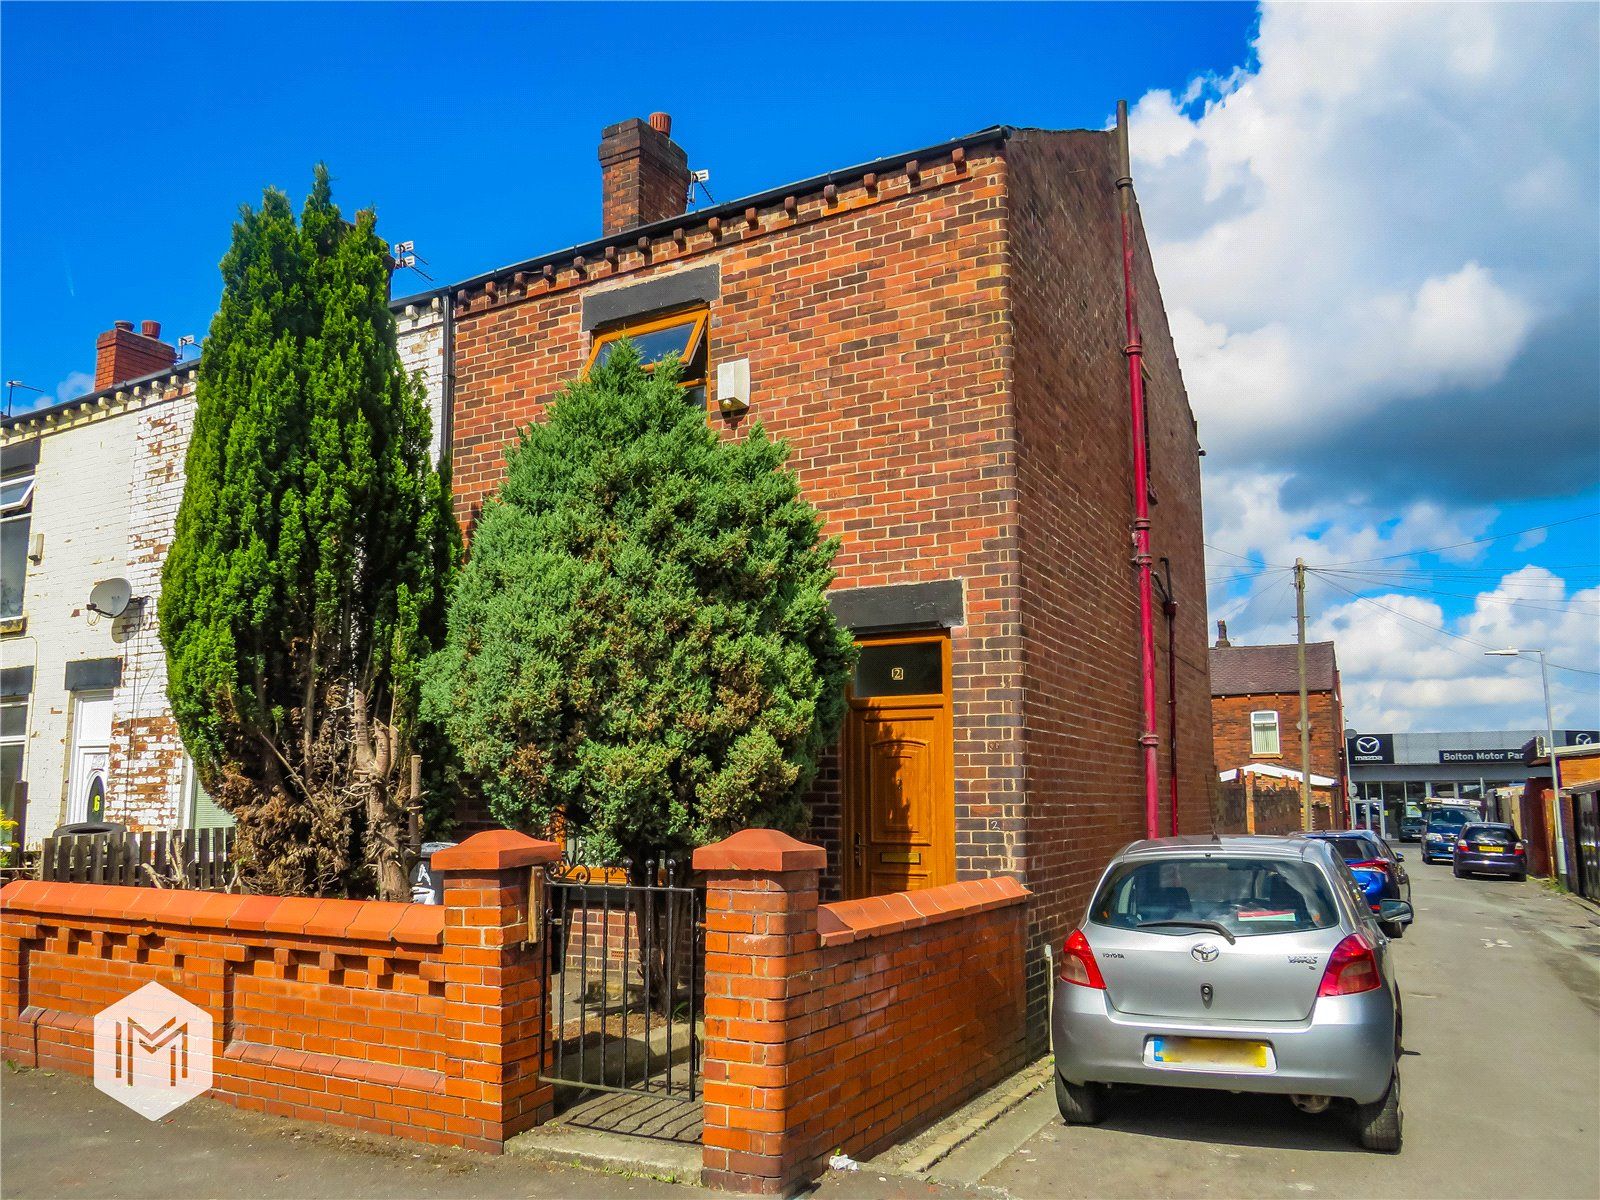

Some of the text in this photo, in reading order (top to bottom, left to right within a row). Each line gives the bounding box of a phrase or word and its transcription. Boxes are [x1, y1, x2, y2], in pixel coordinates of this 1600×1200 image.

[1443, 751, 1525, 761] Bolton Motor Par
[93, 795, 101, 812] 6
